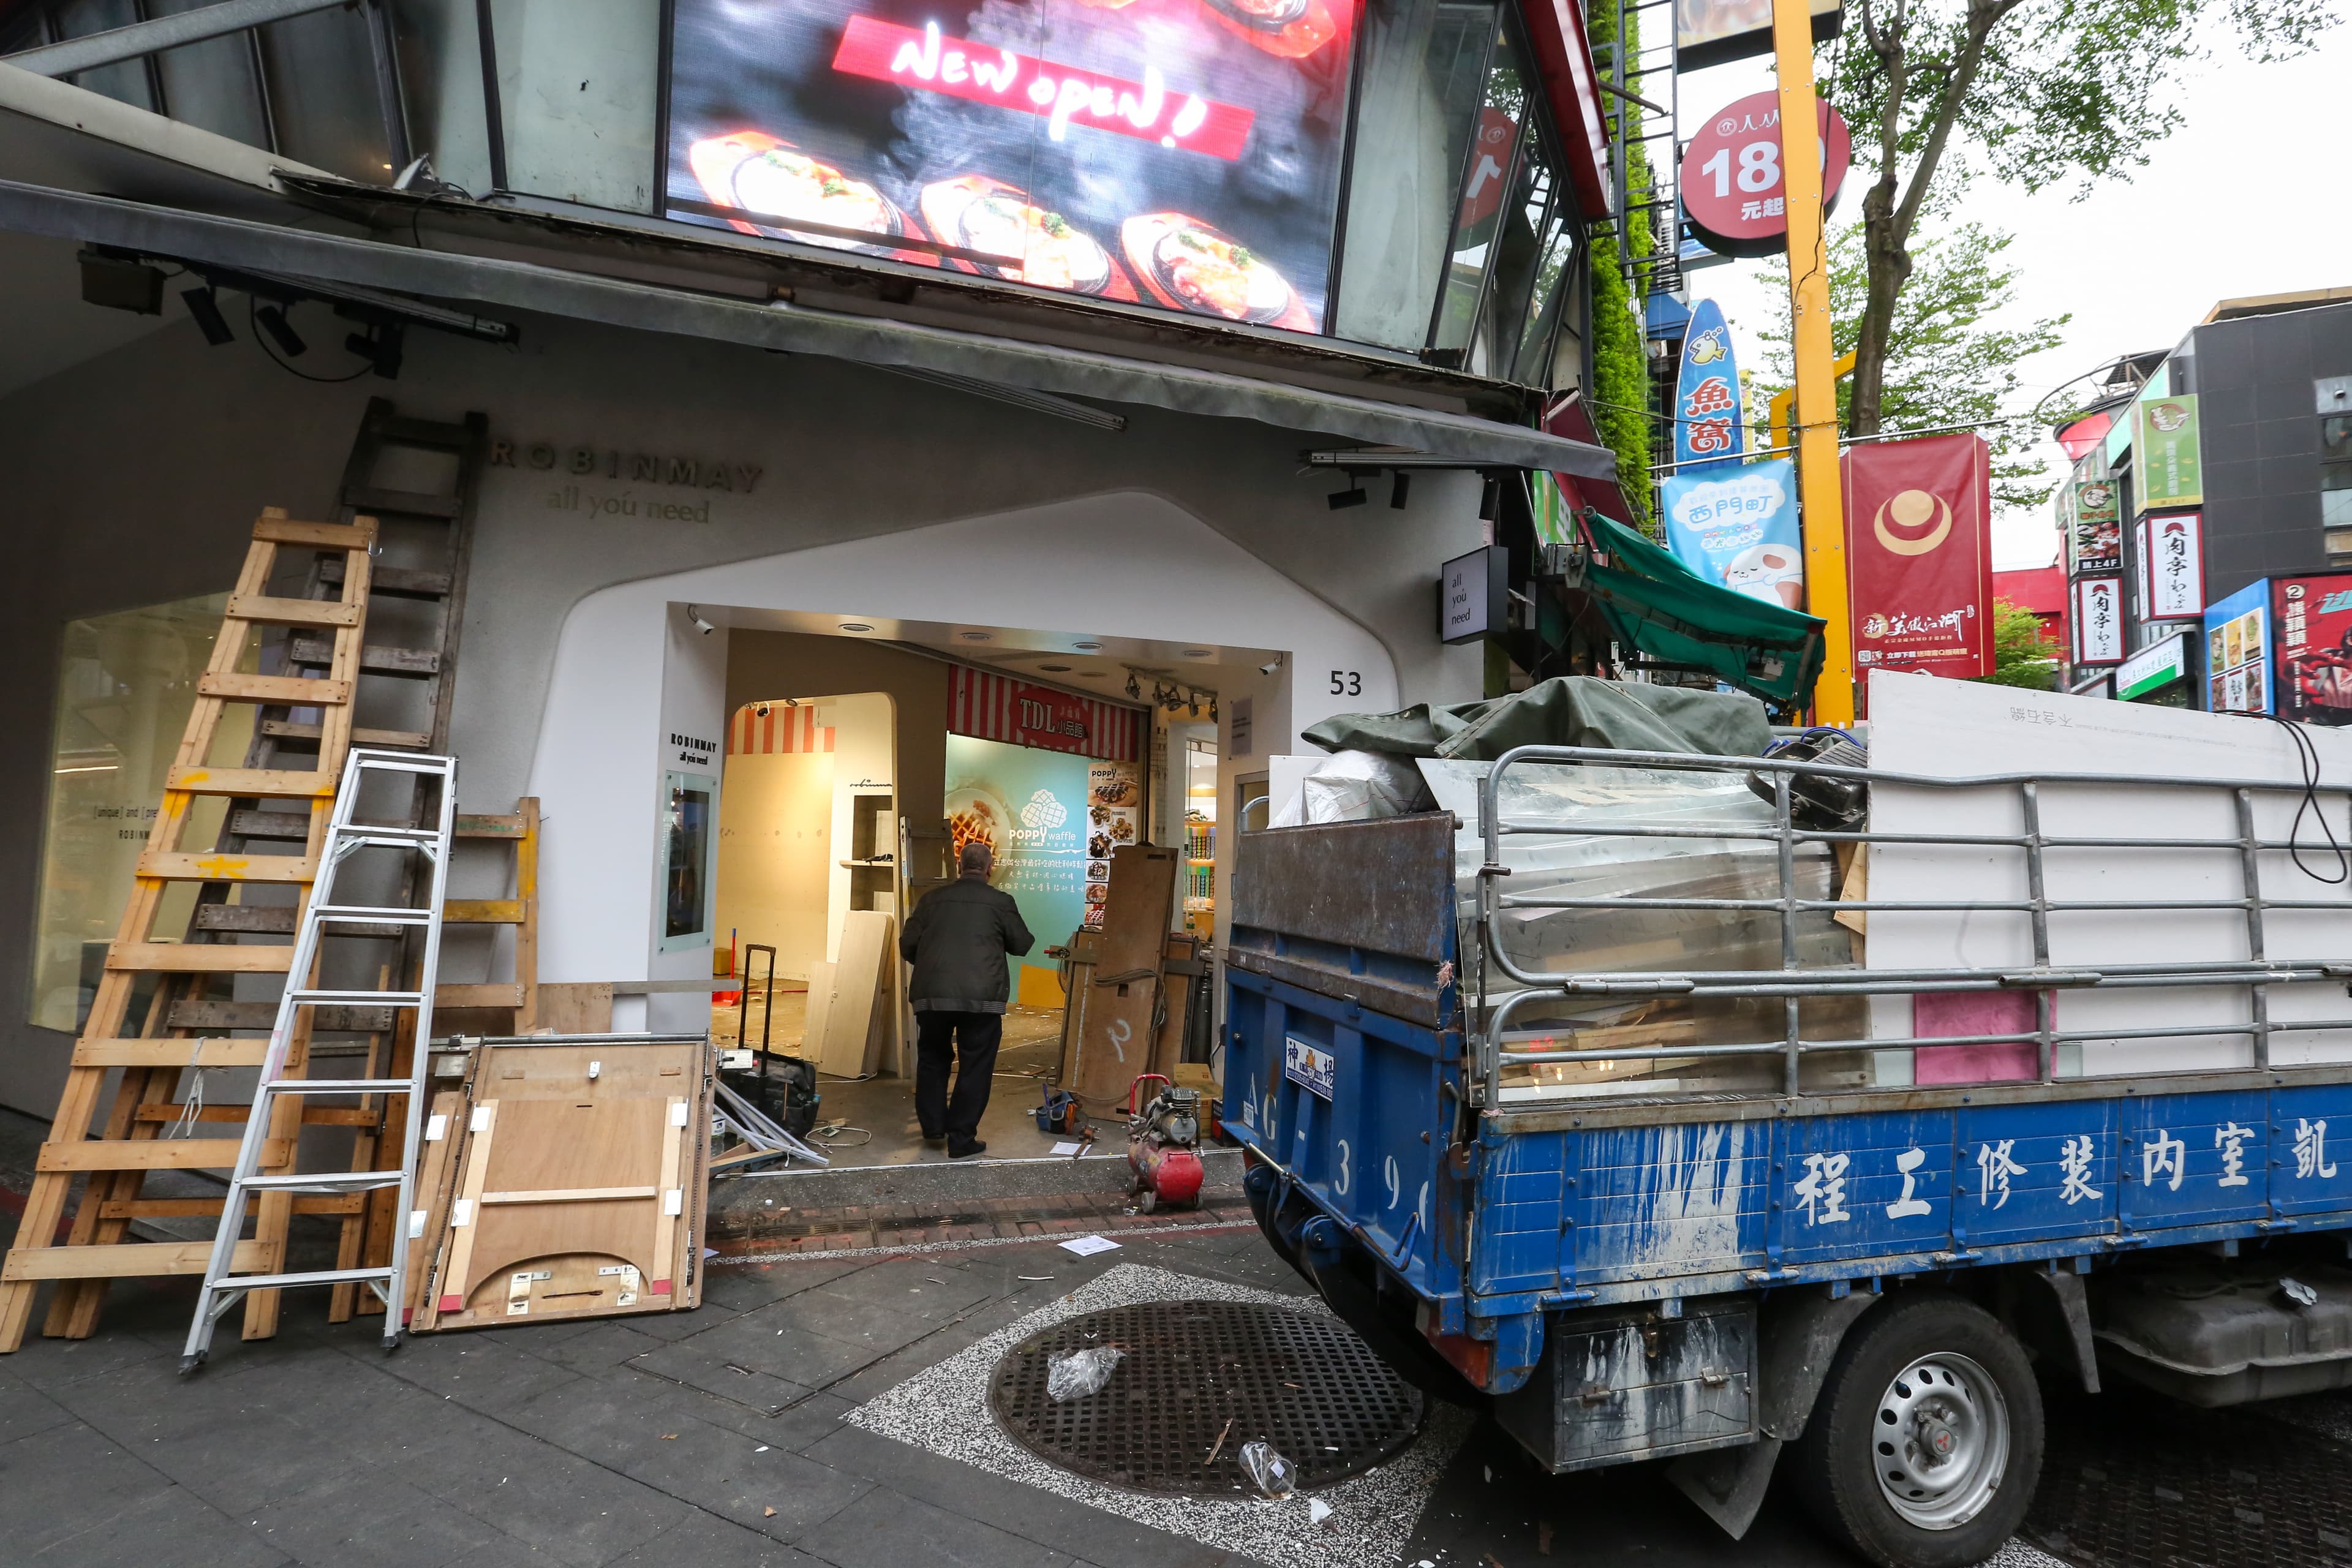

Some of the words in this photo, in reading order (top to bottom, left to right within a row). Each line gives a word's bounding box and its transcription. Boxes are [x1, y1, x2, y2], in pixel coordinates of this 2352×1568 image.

[1739, 109, 1780, 133] 人从
[1702, 136, 1825, 198] 18
[1742, 197, 1784, 221] 元起
[491, 440, 764, 494] ROBINMAY
[548, 486, 579, 511] all
[646, 500, 710, 524] need
[1689, 495, 1773, 524] 西門町
[1452, 573, 1462, 589] all
[1451, 608, 1471, 625] need
[1330, 670, 1362, 696] 53
[1019, 698, 1055, 733] TDL
[1057, 719, 1084, 739] 小品館
[671, 733, 717, 753] ROBINMAY
[696, 755, 707, 765] need
[1092, 769, 1117, 778] POPPY
[119, 829, 149, 839] ROBINM
[1009, 827, 1047, 843] POPPY
[1048, 831, 1076, 842] waffle
